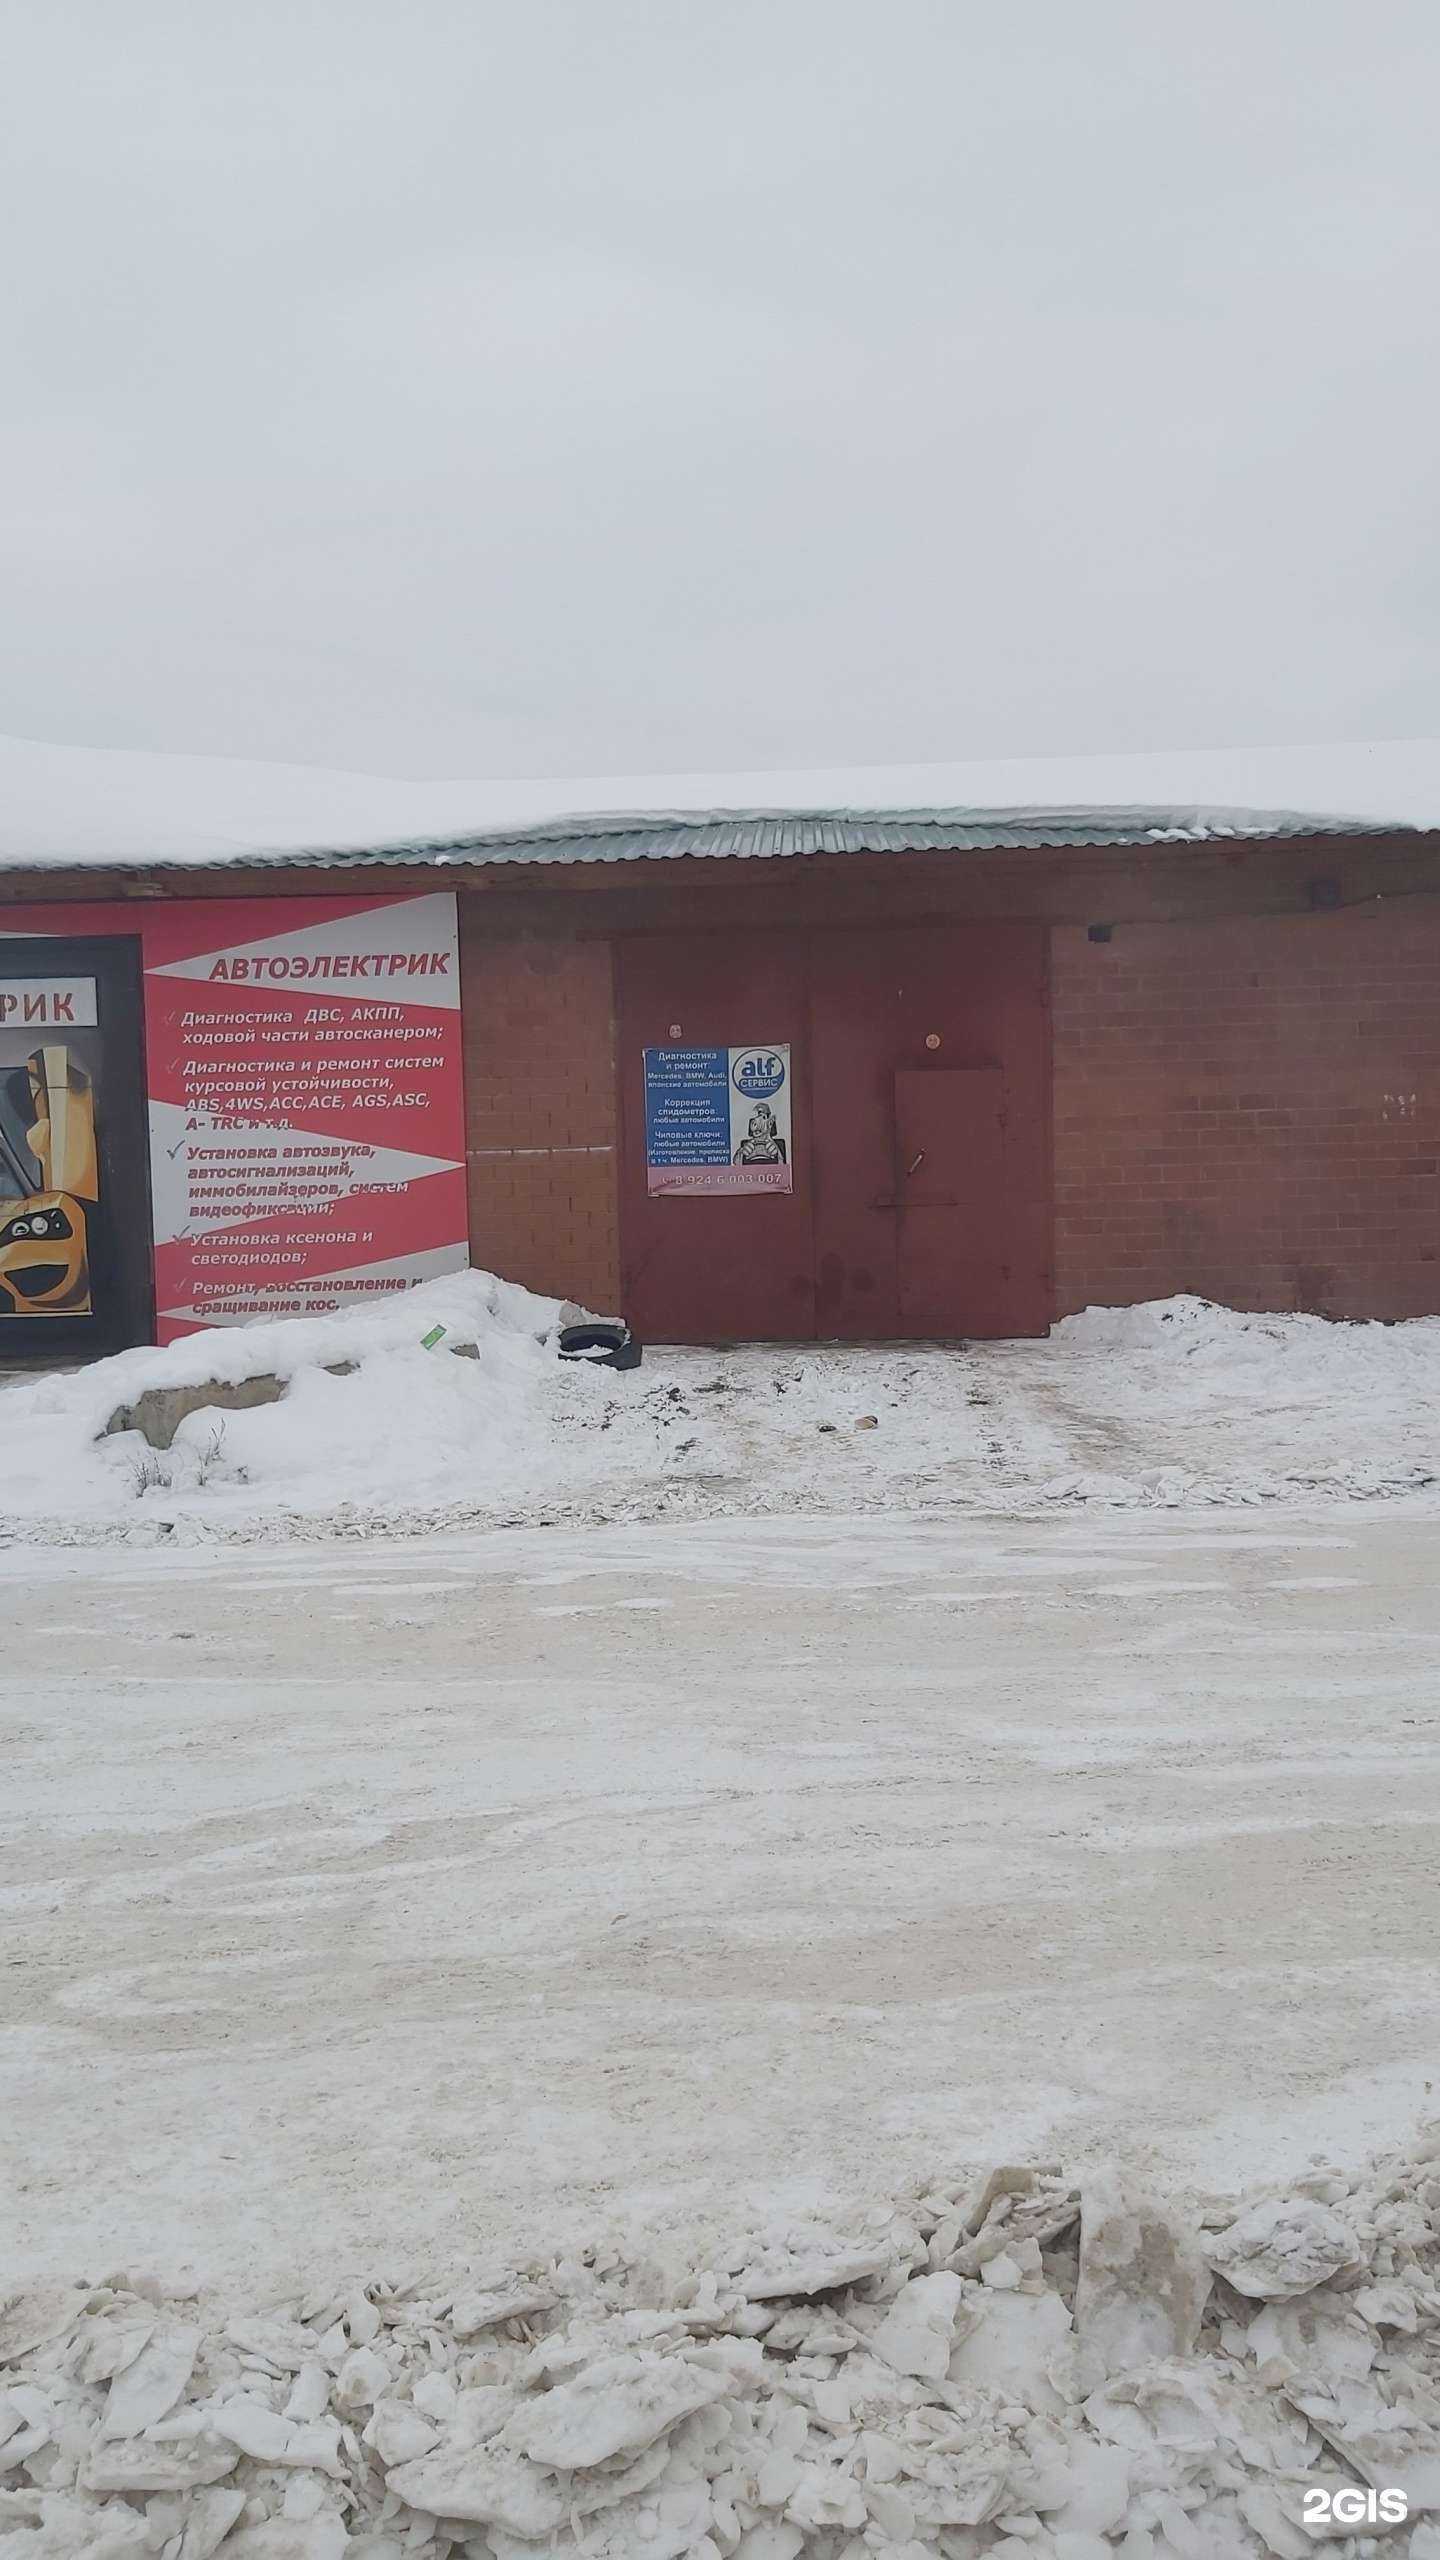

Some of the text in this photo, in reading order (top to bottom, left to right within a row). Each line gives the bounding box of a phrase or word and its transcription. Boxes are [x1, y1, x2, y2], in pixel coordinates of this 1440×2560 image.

[209, 953, 450, 980] АВТОЭЛЕКТРИК
[0, 993, 74, 1021] РИК
[181, 1007, 404, 1026] Диагностика ДВС, АКПП,
[183, 1027, 443, 1045] ходовой части автосканером;
[183, 1056, 444, 1076] Диагностика и ремонт систем
[658, 1052, 717, 1062] Диагностика
[674, 1062, 708, 1071] ремонт
[741, 1057, 776, 1077] alf
[184, 1076, 394, 1095] курсовой устойчивости,
[740, 1078, 778, 1088] СЕРВИС
[184, 1093, 432, 1113] ABS,4WS,ACC,ACE, AGS,ASC,
[211, 1116, 243, 1130] TRC
[187, 1145, 376, 1161] Установка автозвука,
[188, 1162, 354, 1180] автосигнализаций,
[188, 1182, 409, 1199] иммобилайзеров, систем
[190, 1231, 373, 1247] Установка ксенона и
[192, 1251, 307, 1266] светодиодов;
[192, 1282, 258, 1297] Ремонт,
[265, 1278, 407, 1293] восстановление
[192, 1300, 300, 1315] сращивание
